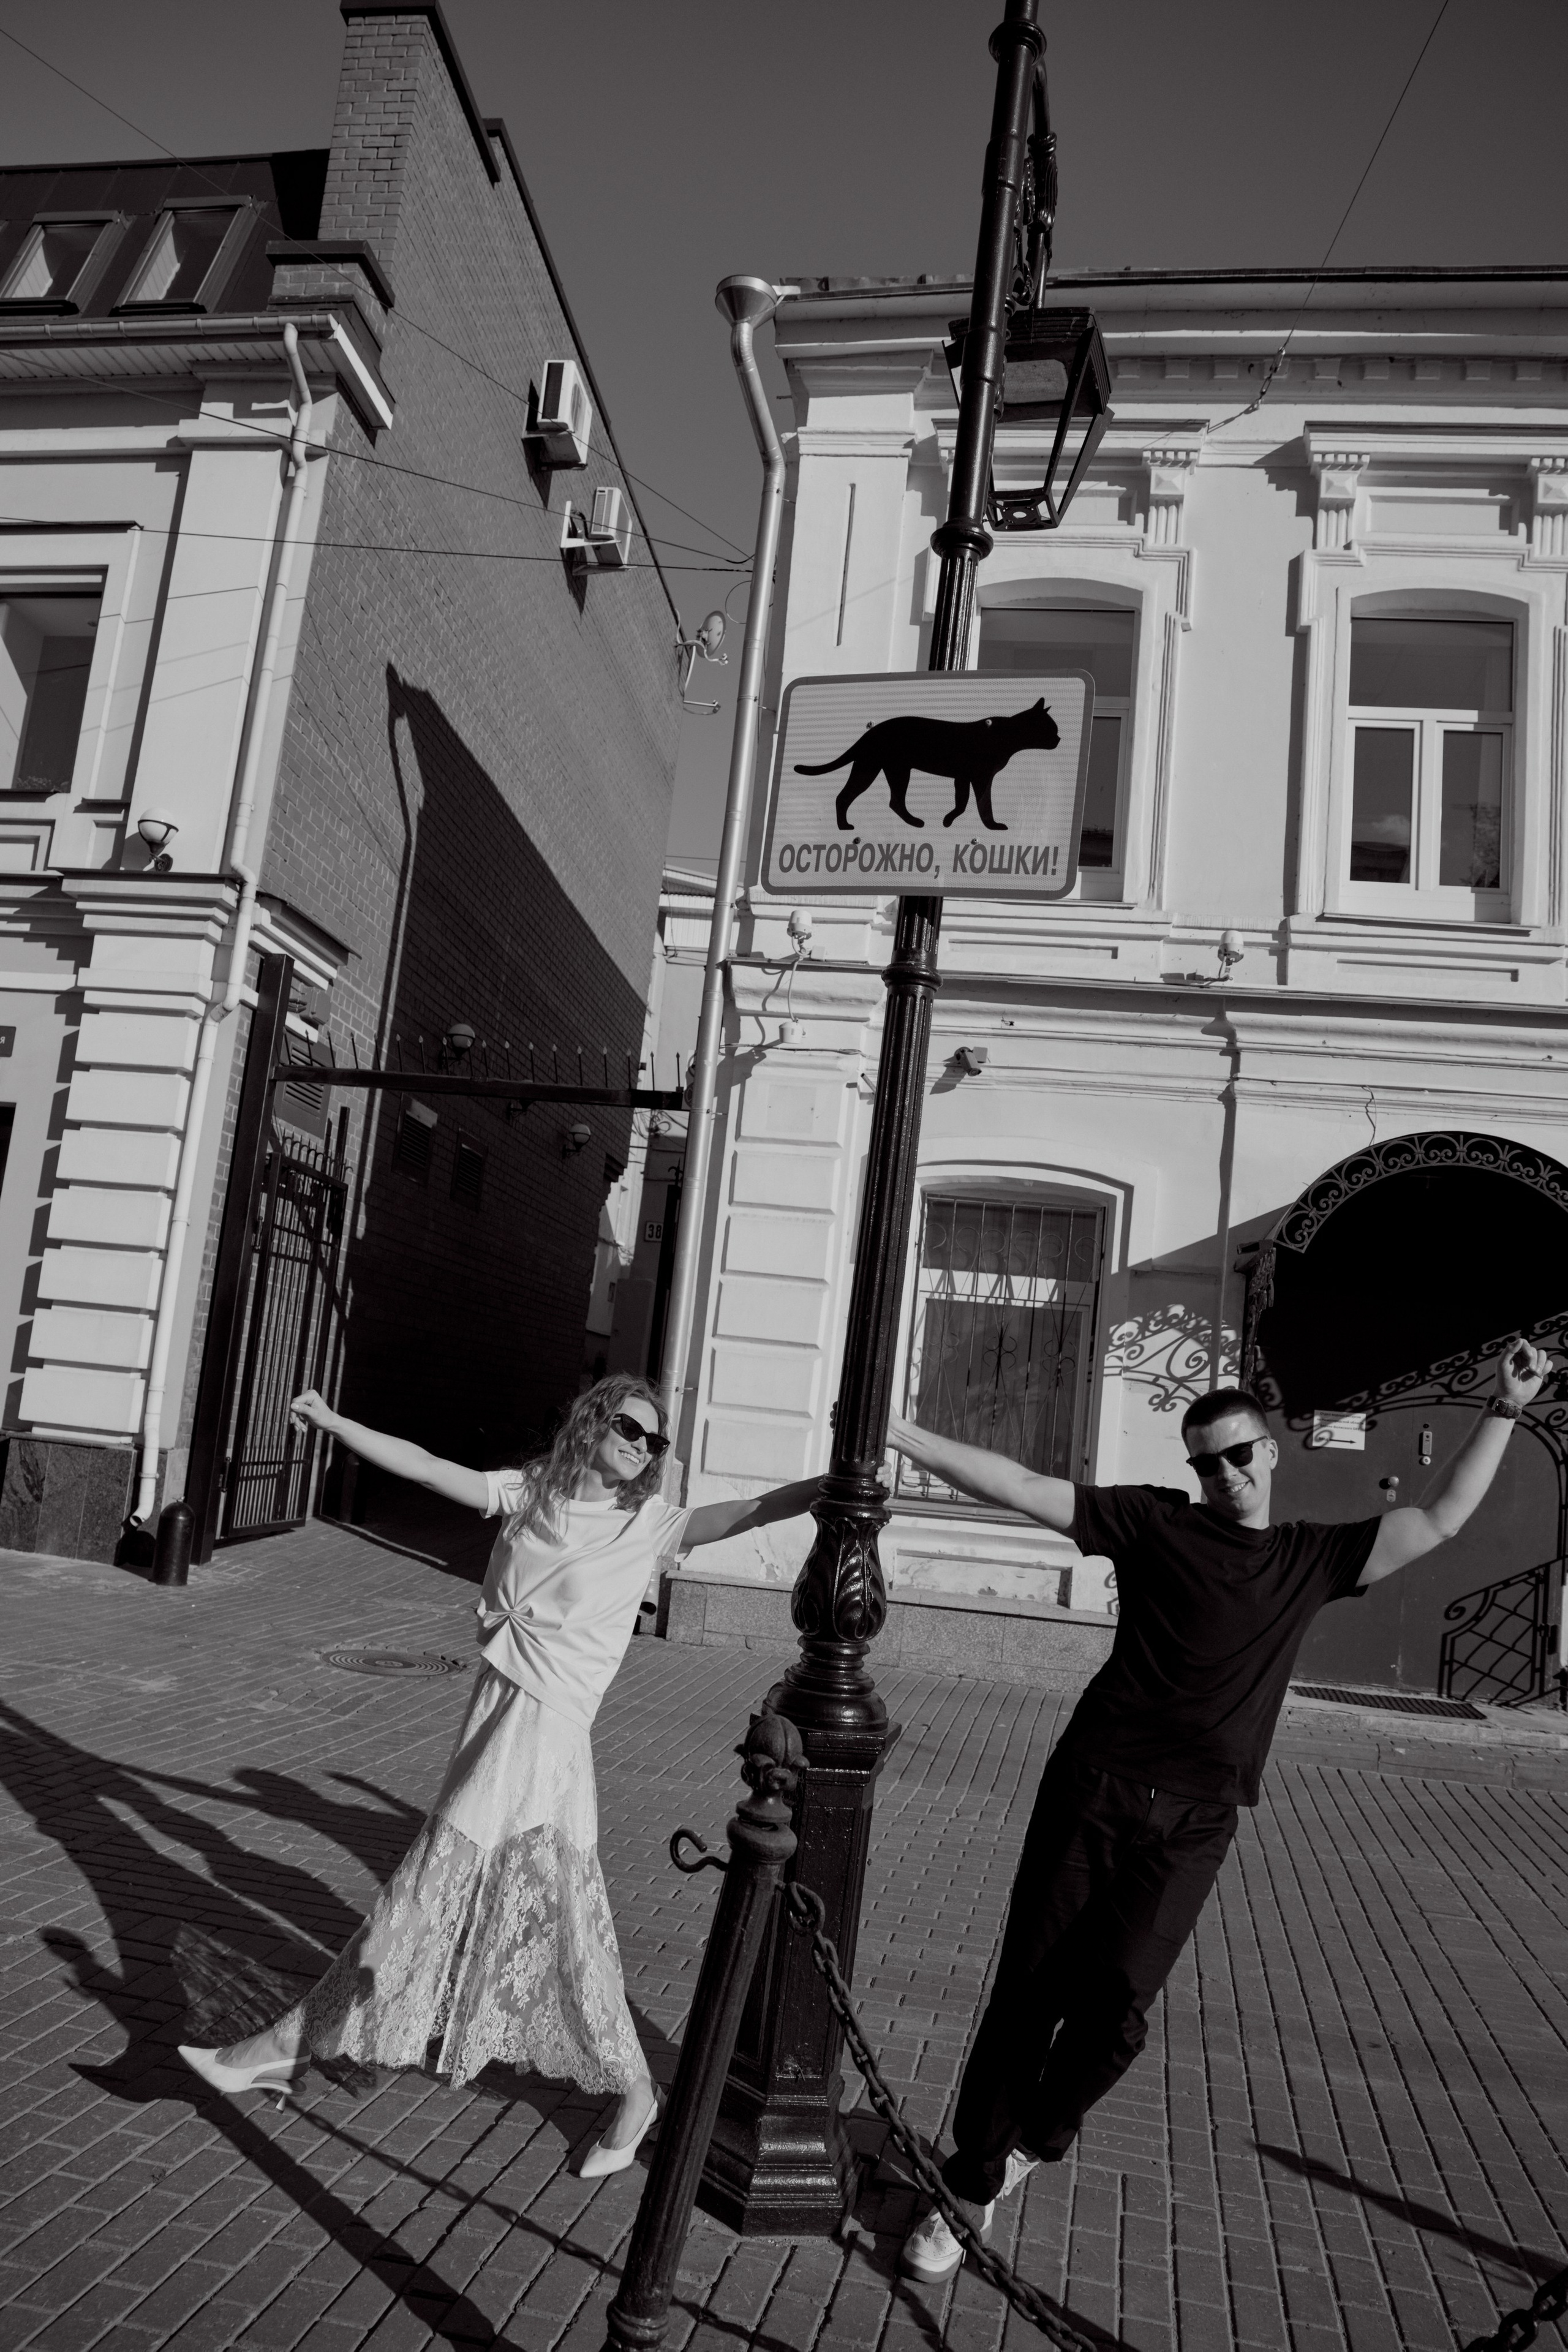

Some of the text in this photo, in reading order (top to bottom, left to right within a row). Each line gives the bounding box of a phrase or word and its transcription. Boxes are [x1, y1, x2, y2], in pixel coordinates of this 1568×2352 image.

[778, 843, 1059, 879] ОСТОРОЖНО, КОШКИ!
[647, 1224, 662, 1239] 38
